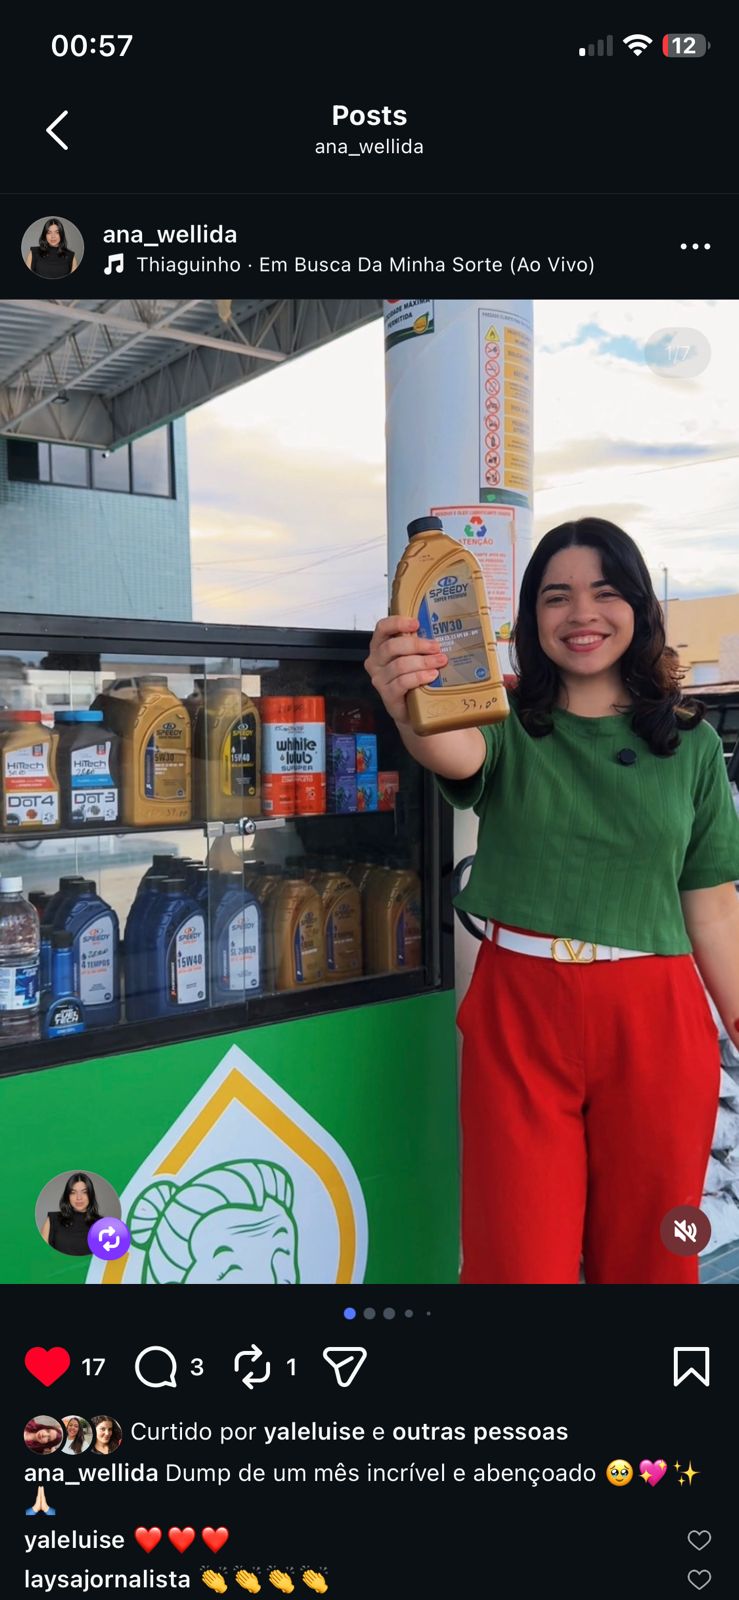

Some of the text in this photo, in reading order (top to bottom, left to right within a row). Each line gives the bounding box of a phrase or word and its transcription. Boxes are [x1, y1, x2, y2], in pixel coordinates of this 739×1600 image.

[429, 583, 469, 599] SPEEDY
[432, 619, 463, 635] 5W30
[156, 729, 183, 737] SPEEDY
[232, 729, 254, 737] SPEEDY
[7, 762, 44, 770] HiTech
[74, 760, 107, 768] HiTech
[41, 795, 54, 805] 4
[105, 792, 115, 803] 3
[231, 923, 255, 931] SPEEDY
[178, 932, 202, 942] SPEEDY
[177, 954, 203, 968] 15W40
